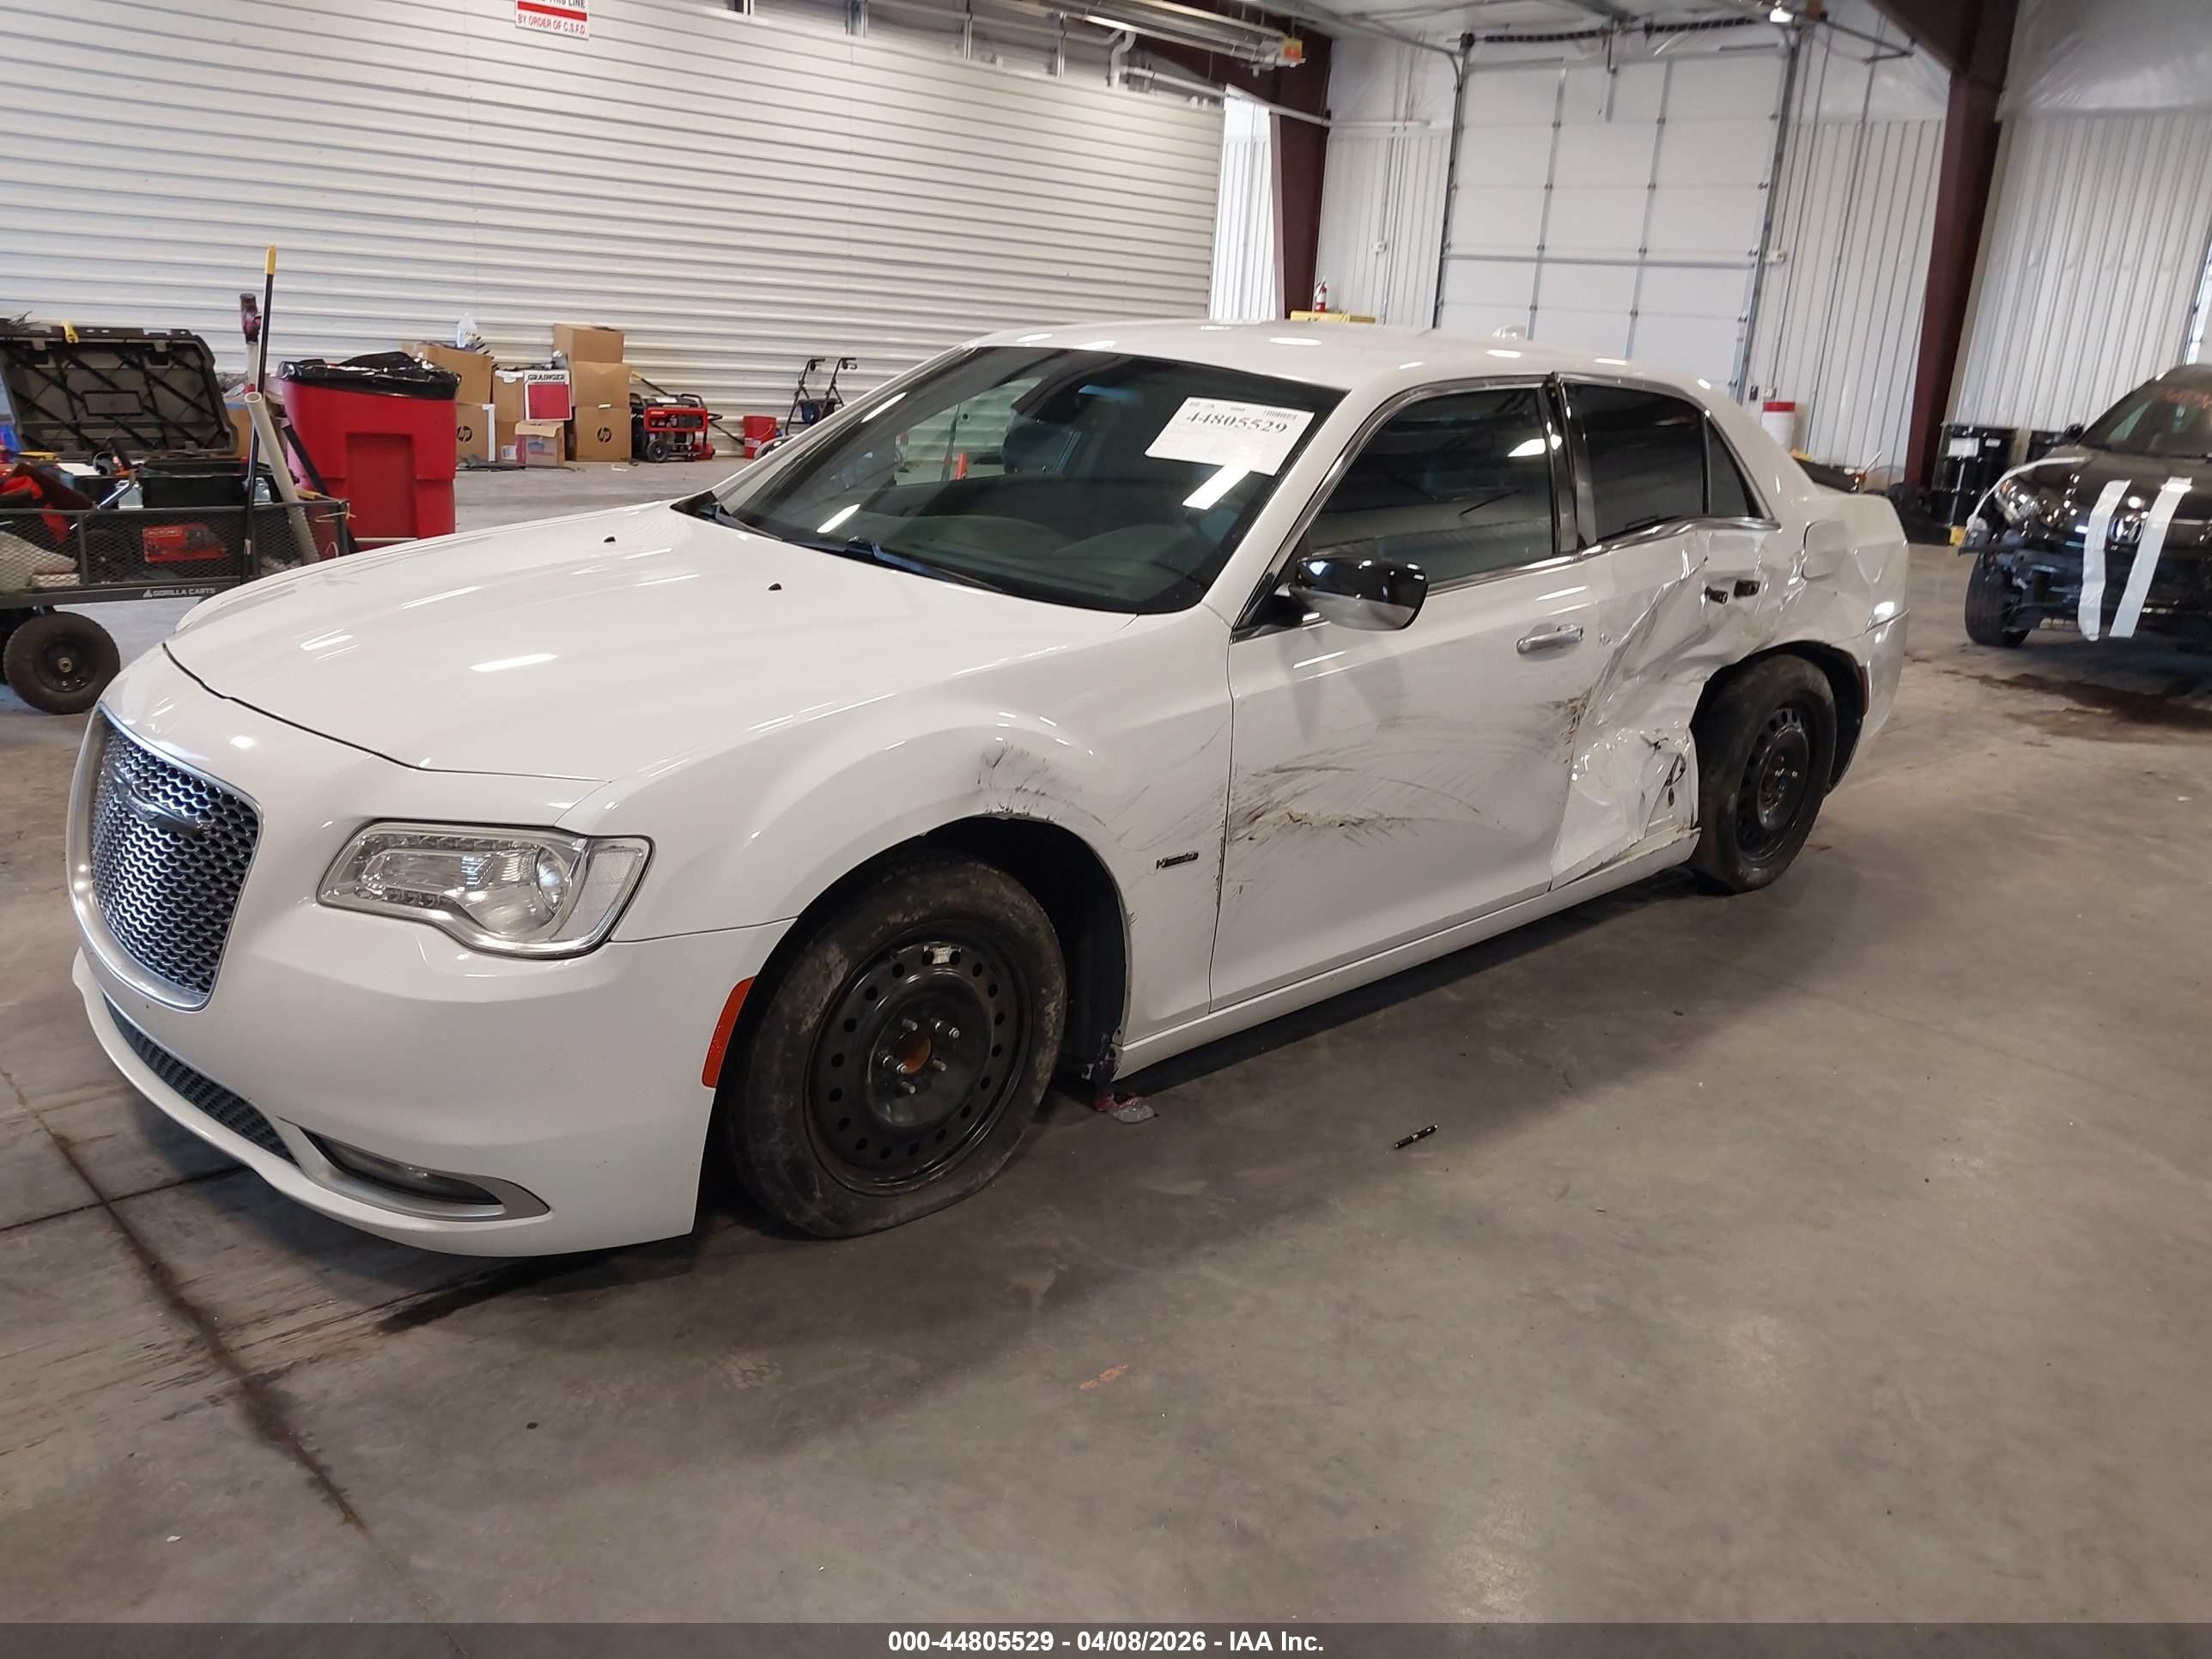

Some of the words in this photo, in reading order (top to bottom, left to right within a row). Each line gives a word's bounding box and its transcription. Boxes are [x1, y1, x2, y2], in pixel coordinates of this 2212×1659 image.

[517, 13, 526, 25] BY
[528, 15, 552, 28] ORDER
[553, 19, 562, 30] OF
[1187, 411, 1288, 434] 44805529
[457, 426, 472, 442] hp
[597, 427, 612, 443] hp
